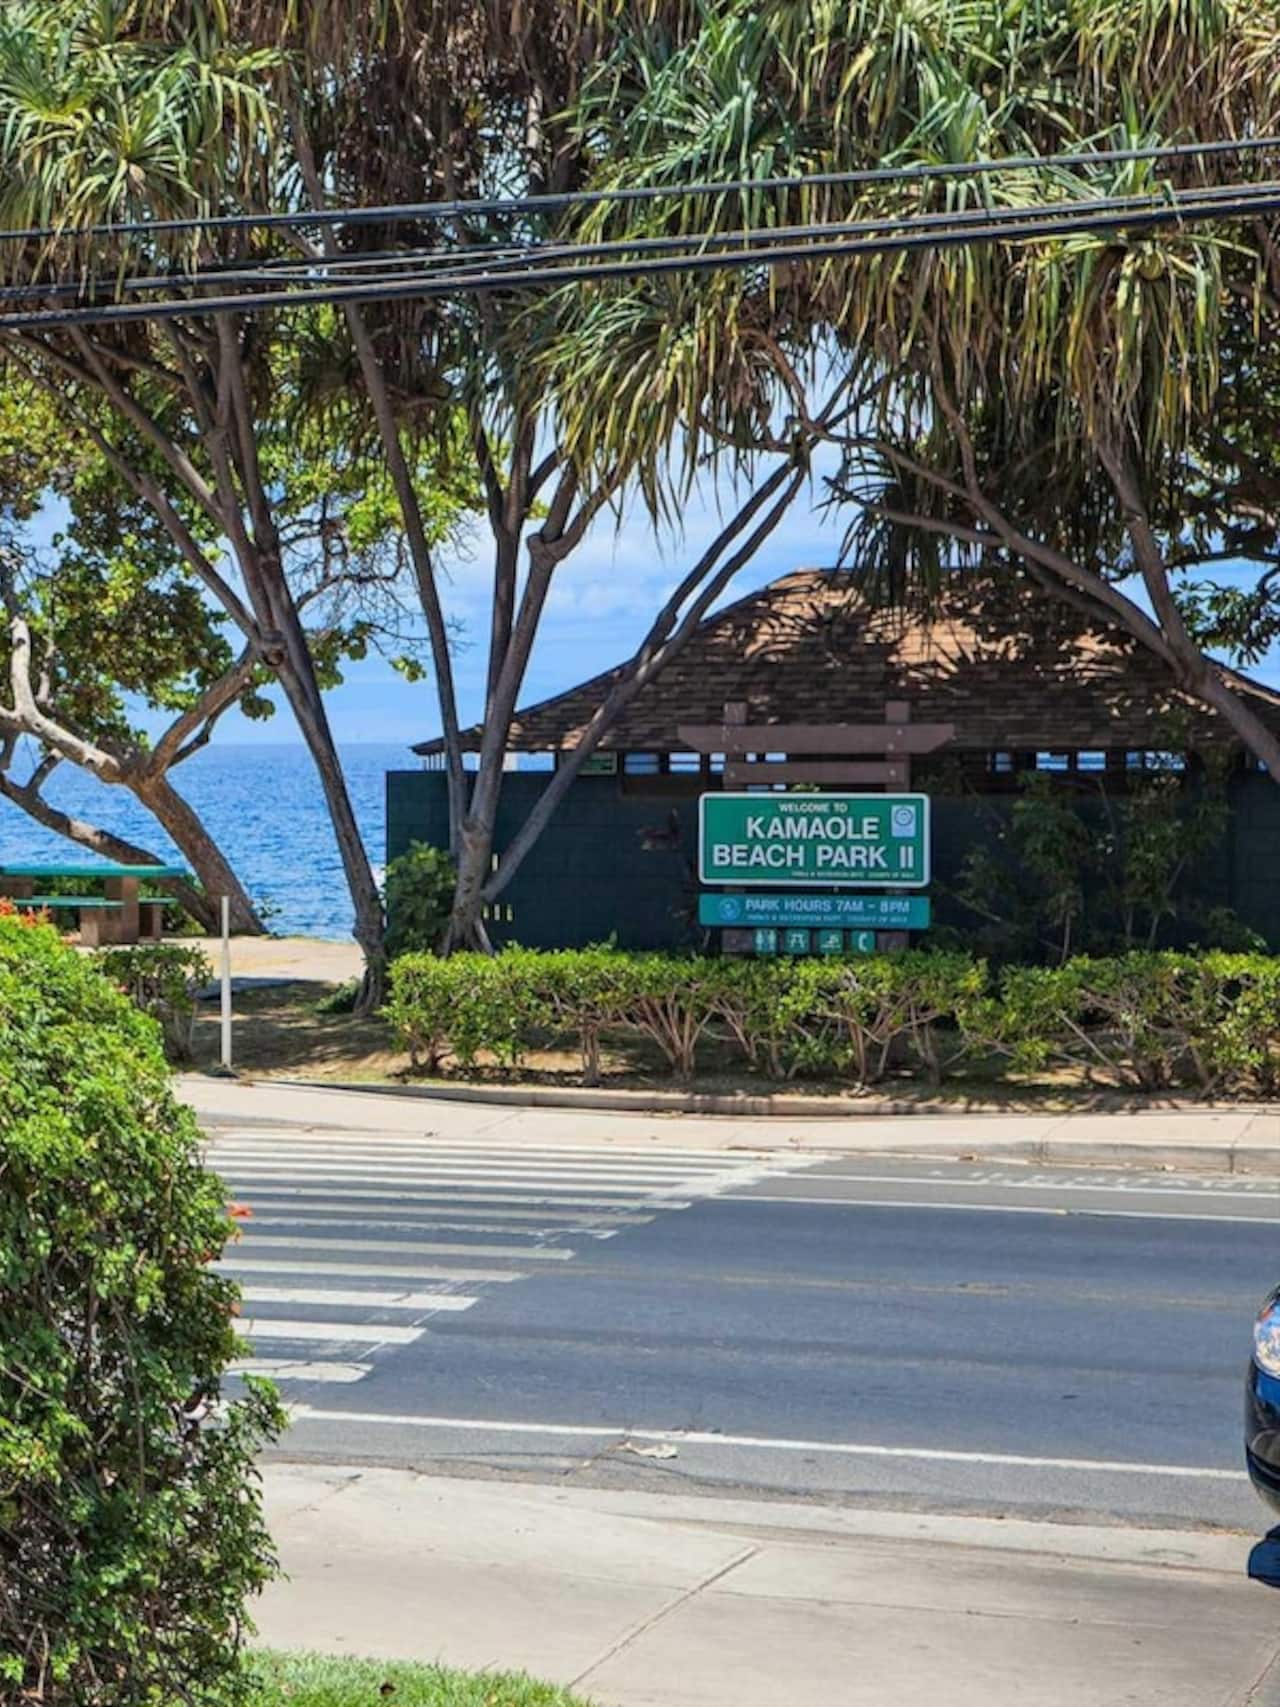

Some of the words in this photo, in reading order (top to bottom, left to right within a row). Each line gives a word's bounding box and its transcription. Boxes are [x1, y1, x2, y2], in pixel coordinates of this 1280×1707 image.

[779, 803, 829, 813] WELCOME
[833, 803, 848, 813] TO
[746, 816, 880, 840] KAMAOLE
[712, 844, 804, 868] BEACH
[817, 845, 887, 868] PARK
[899, 846, 914, 869] II
[745, 899, 780, 912] PARK
[784, 899, 832, 913] HOURS
[836, 900, 865, 913] 7AM
[880, 900, 910, 914] 8PM
